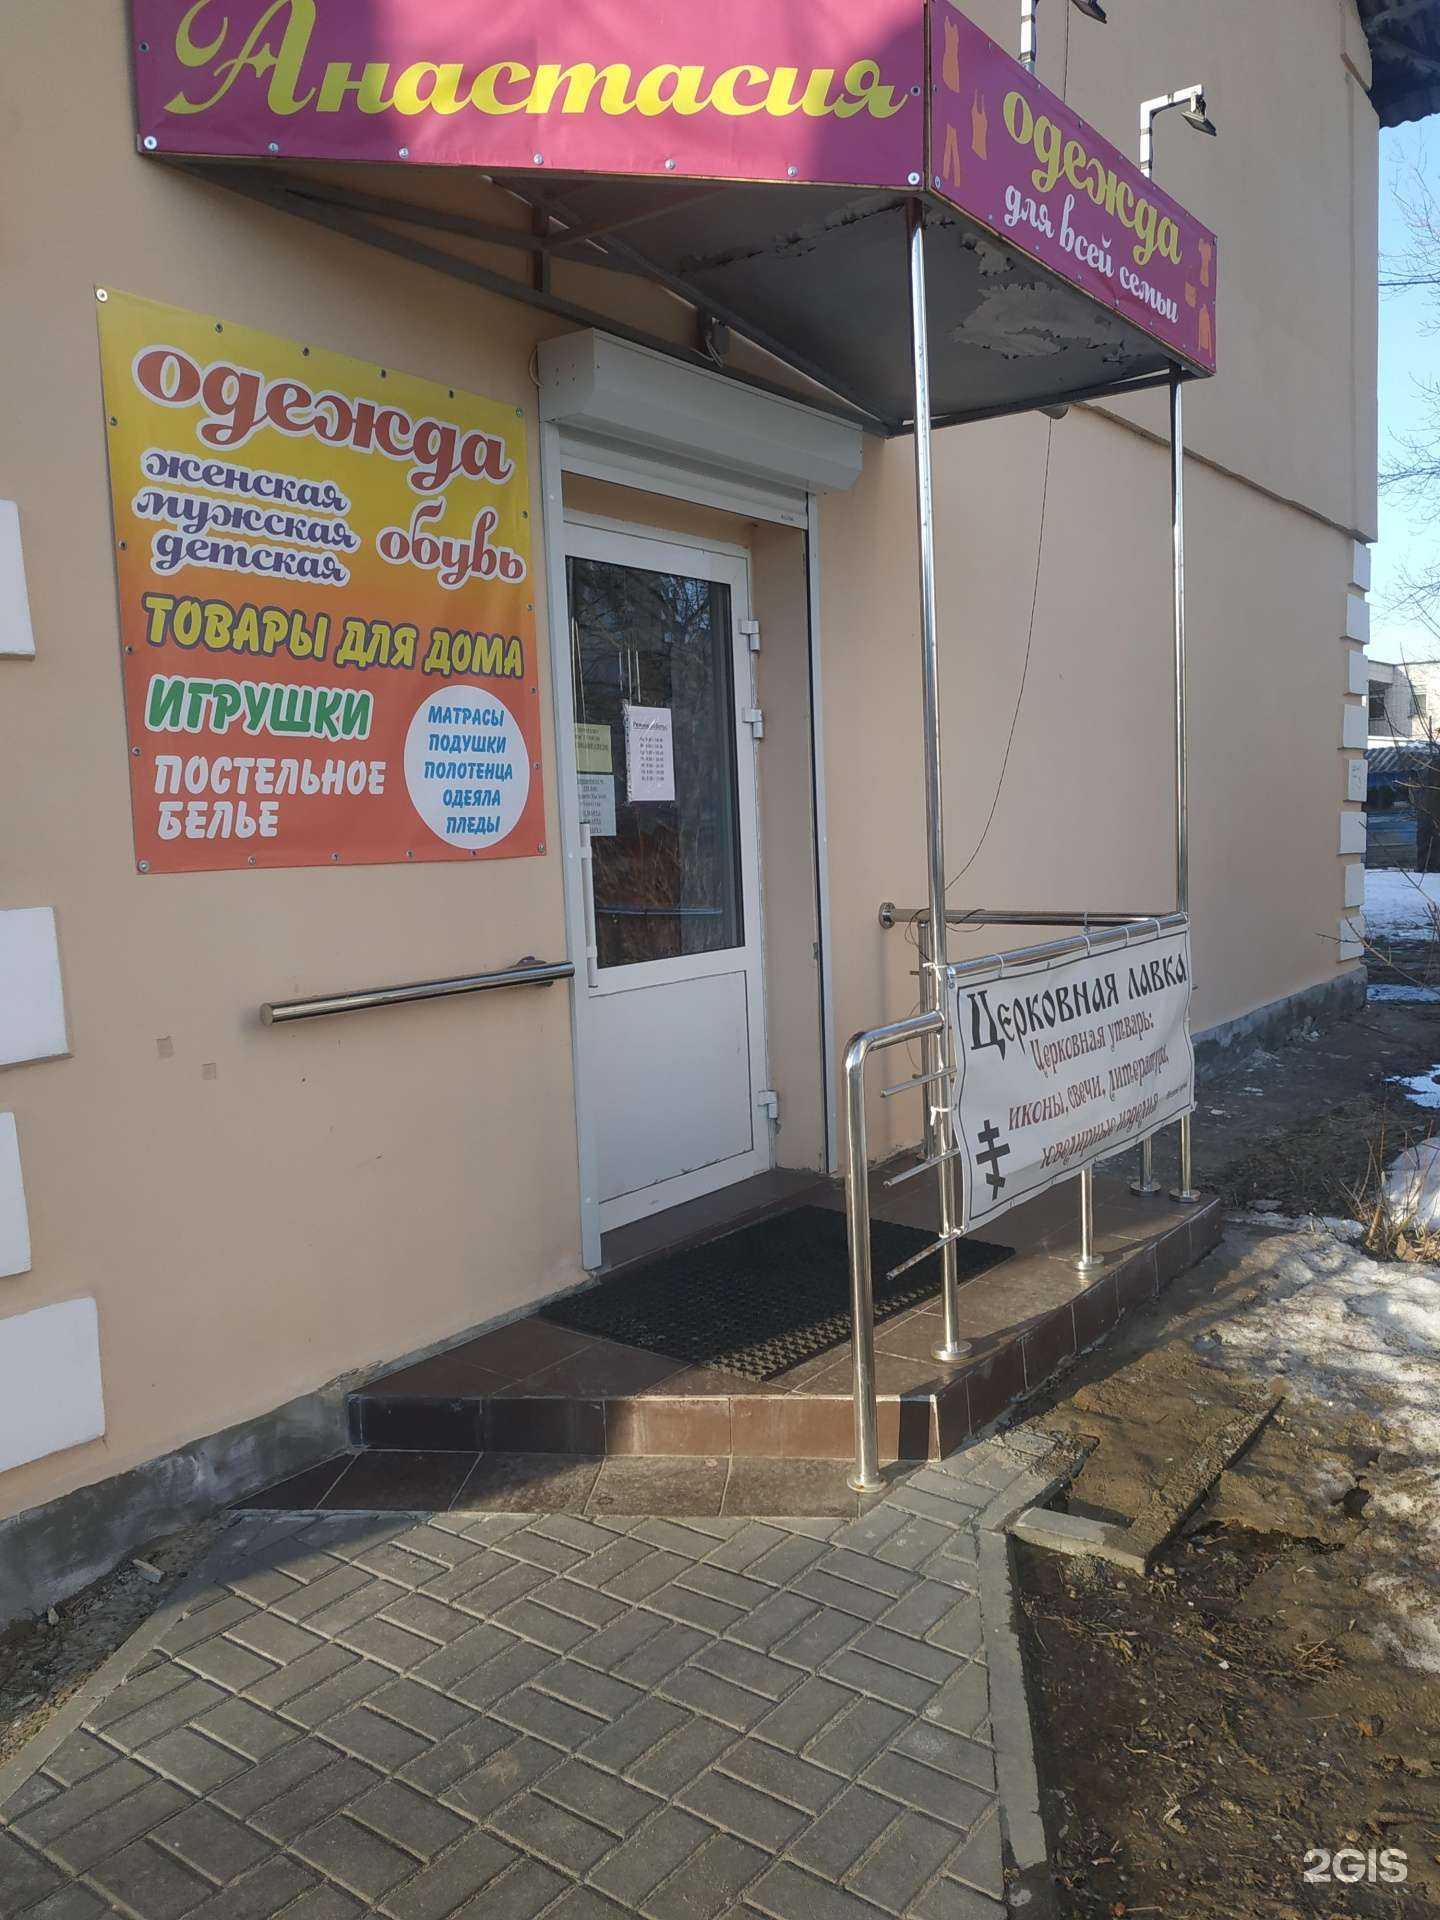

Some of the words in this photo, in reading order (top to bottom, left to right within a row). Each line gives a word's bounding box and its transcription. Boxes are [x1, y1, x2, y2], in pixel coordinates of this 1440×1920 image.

[164, 0, 908, 119] Анастасия
[1005, 185, 1055, 238] для
[1060, 194, 1115, 278] всей
[1119, 265, 1179, 323] семьи
[145, 452, 348, 512] женская
[136, 490, 357, 548] мужская
[379, 504, 525, 586] обувь
[154, 531, 347, 583] детская
[144, 594, 328, 660] ТОВАРЫ
[335, 619, 418, 669] ДЛЯ
[422, 630, 525, 678] ДОМА
[147, 677, 371, 739] ИГРУШКИ
[427, 705, 505, 727] МАТРАСЫ
[428, 732, 507, 755] ПОДУШКИ
[153, 755, 387, 795] ПОСТЕЛЬНОЕ
[423, 761, 514, 782] ПОЛОТЕНЦА
[157, 801, 280, 840] БЕЛЬЕ
[442, 789, 502, 808] ОДЕЯЛА
[445, 815, 501, 834] ПЛЕДЫ
